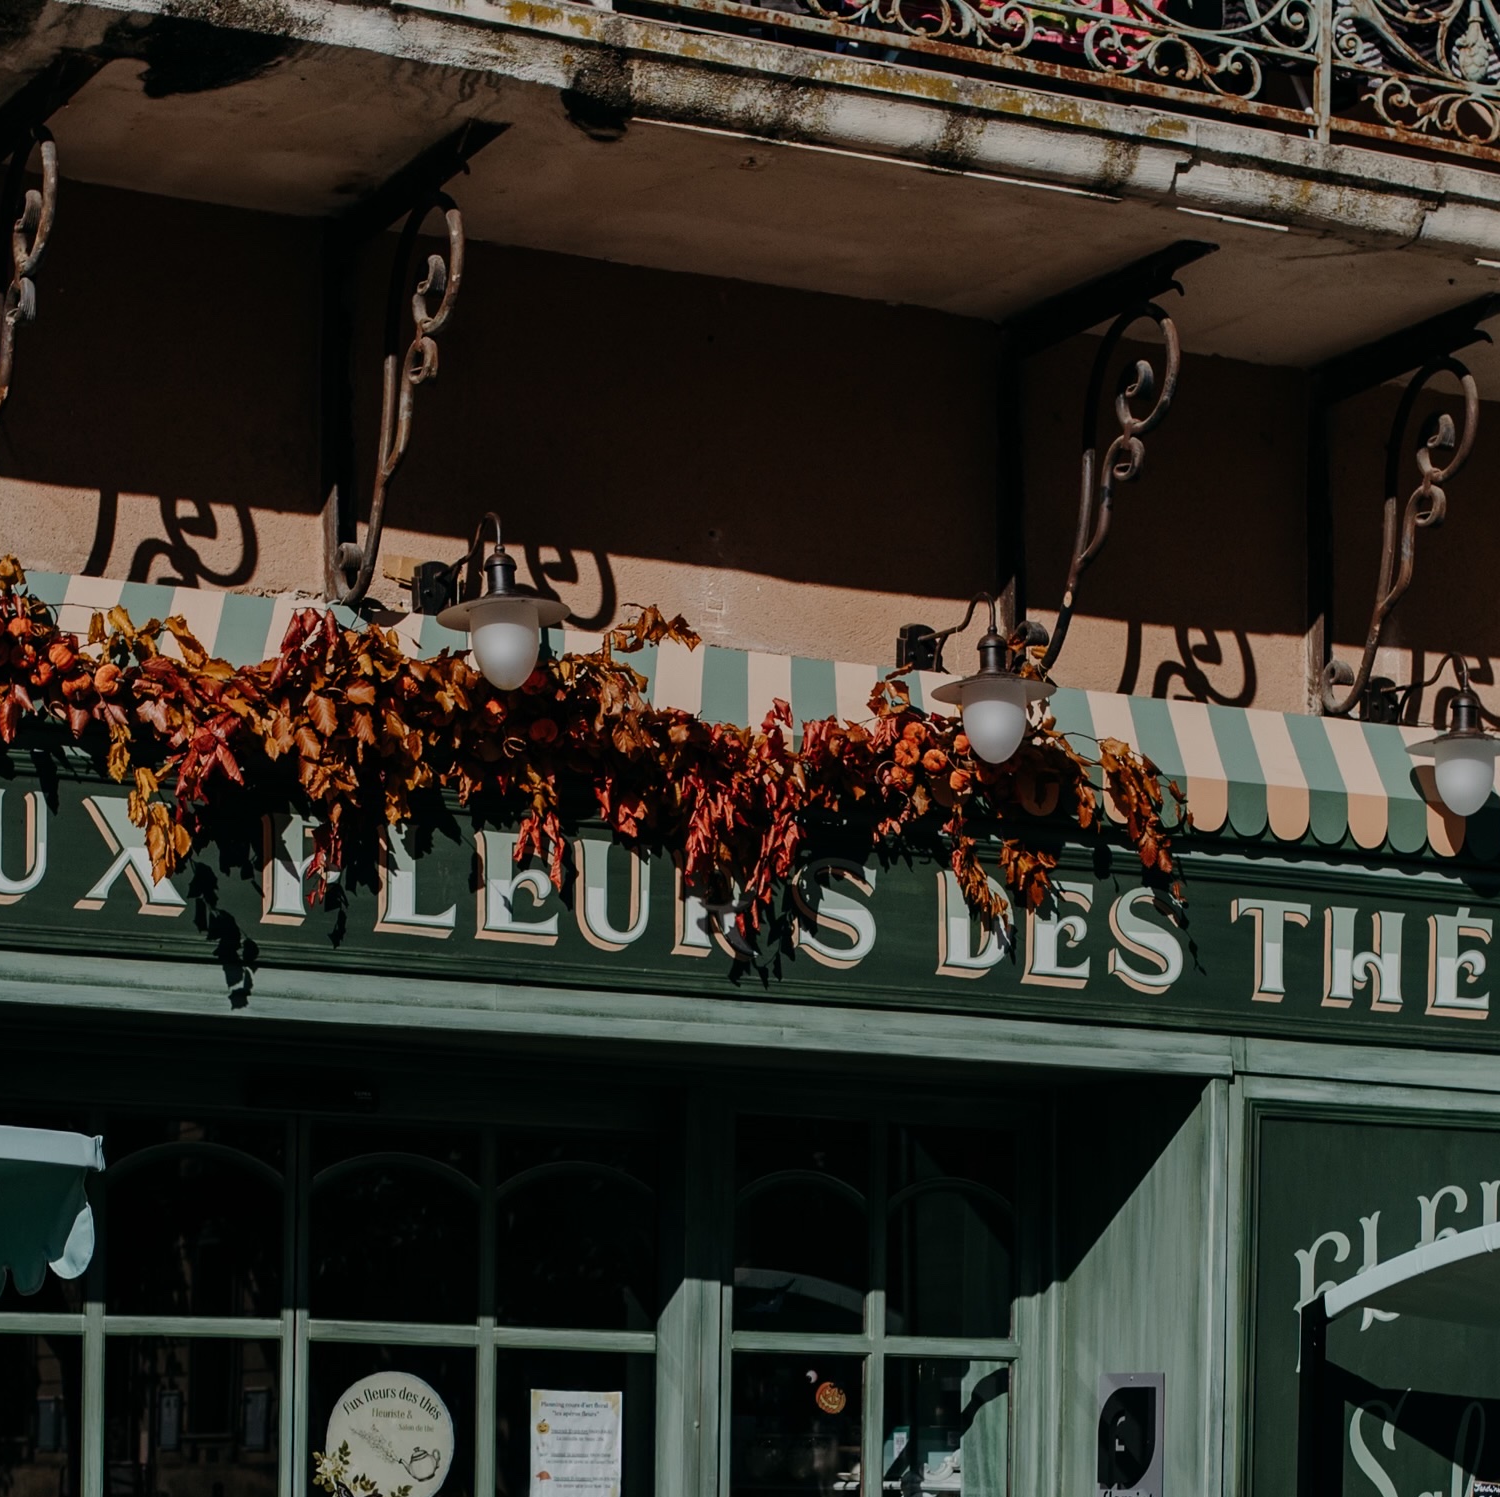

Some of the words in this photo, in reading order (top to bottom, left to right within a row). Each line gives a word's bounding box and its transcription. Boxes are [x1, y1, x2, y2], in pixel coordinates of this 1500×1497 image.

[935, 868, 1184, 994] DES
[363, 1387, 397, 1403] fleurs
[398, 1386, 419, 1404] des
[419, 1396, 442, 1421] thés
[406, 1410, 413, 1419] &
